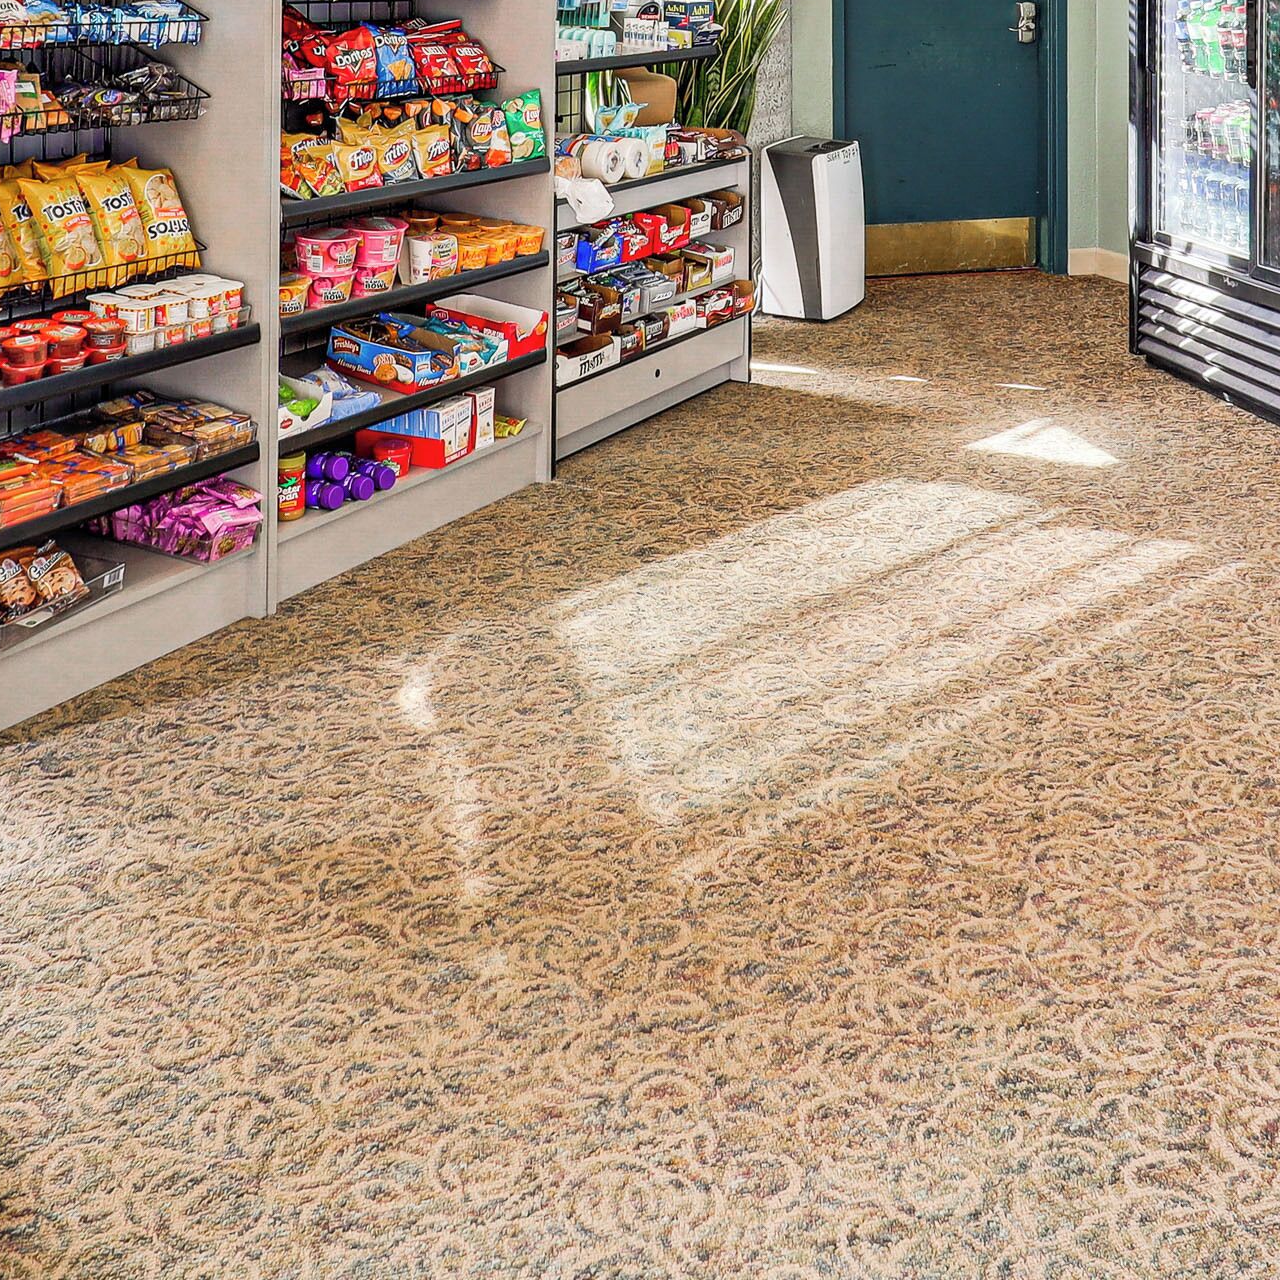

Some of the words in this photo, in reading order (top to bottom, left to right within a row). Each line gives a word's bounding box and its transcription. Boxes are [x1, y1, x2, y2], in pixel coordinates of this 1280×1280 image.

[666, 3, 685, 13] Advil
[692, 3, 710, 16] Advil
[335, 46, 374, 68] Doritos
[279, 492, 299, 503] Pan
